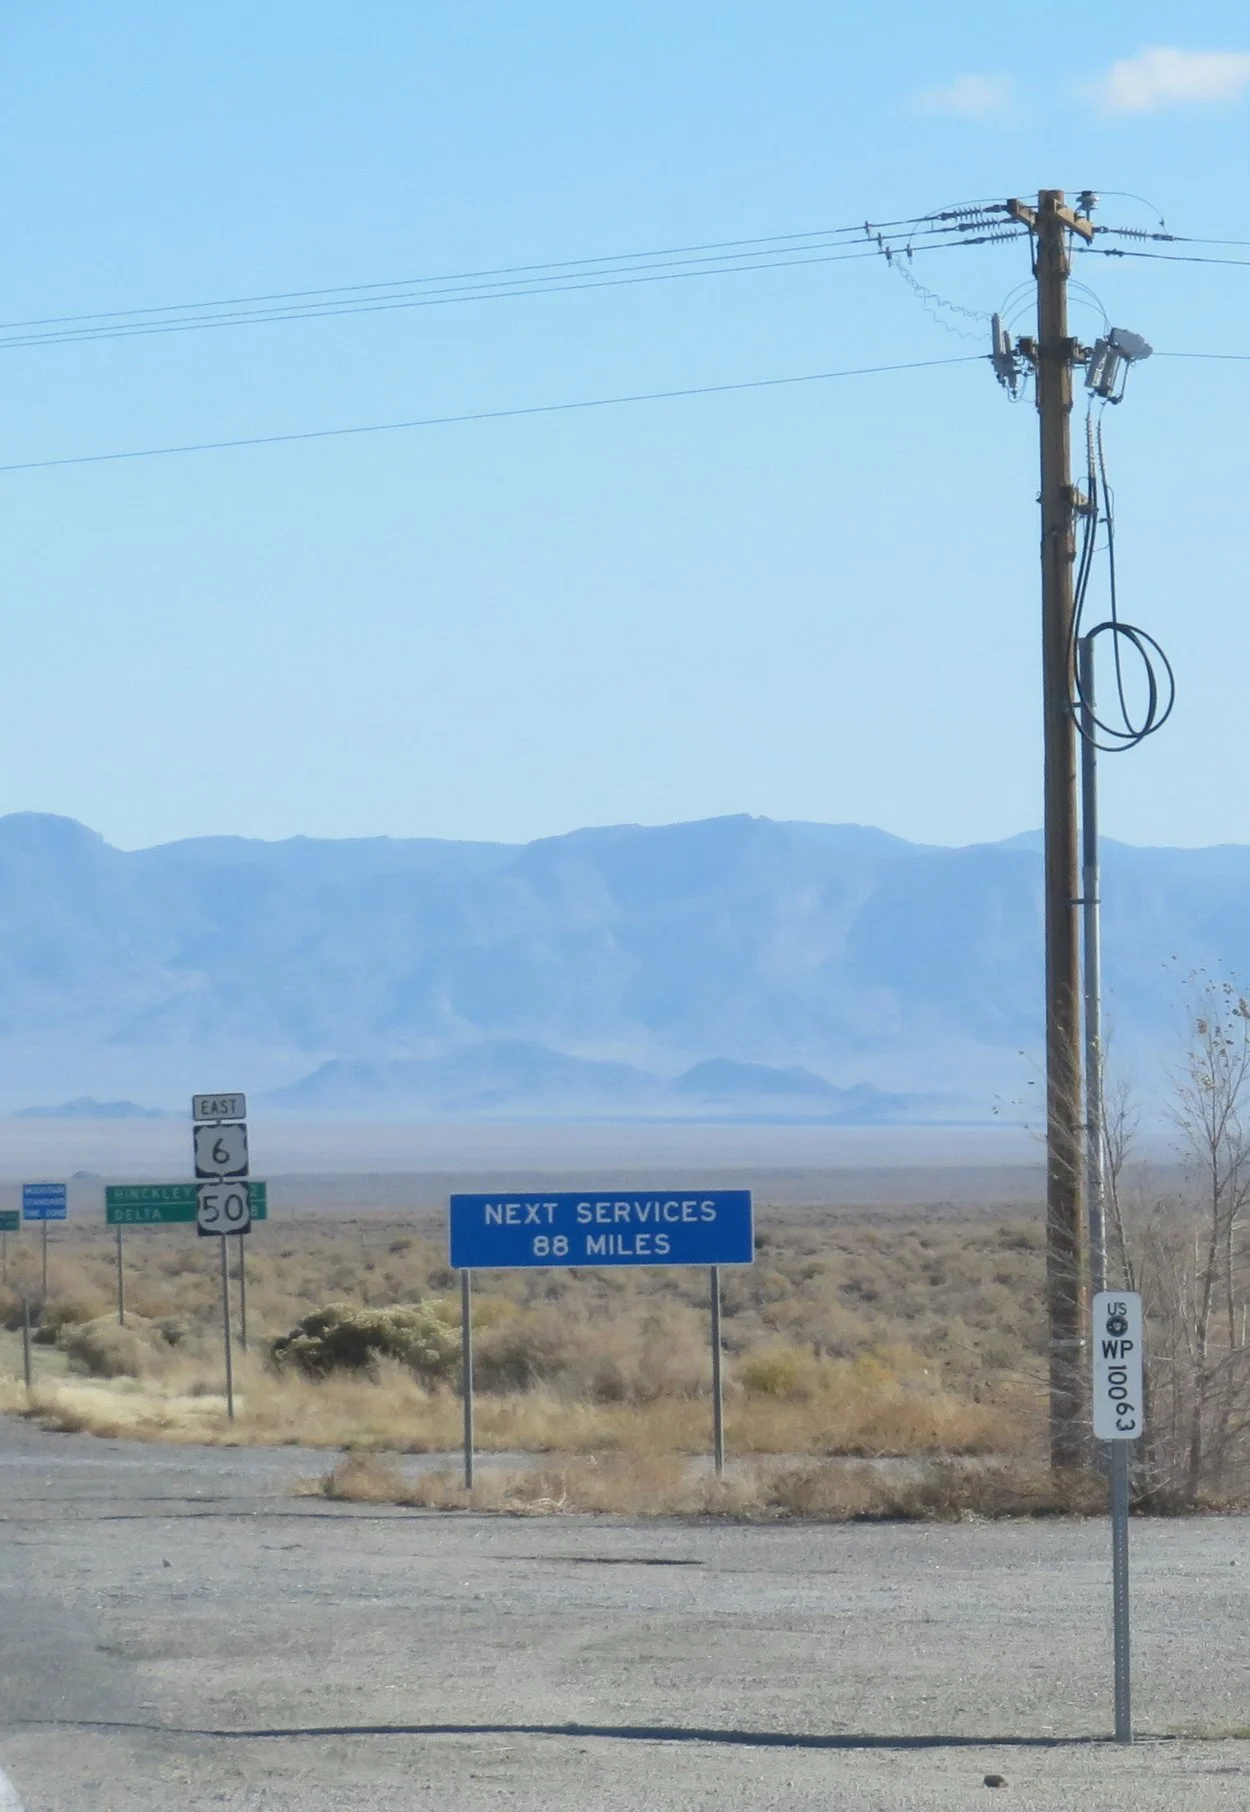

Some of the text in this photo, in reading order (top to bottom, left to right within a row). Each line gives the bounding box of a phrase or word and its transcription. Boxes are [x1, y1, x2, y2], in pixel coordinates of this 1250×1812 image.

[201, 1099, 237, 1116] EAST
[211, 1137, 230, 1164] 6
[114, 1187, 193, 1200] HINCKLEY
[114, 1208, 162, 1221] DELTA
[203, 1194, 243, 1222] 50
[484, 1201, 717, 1225] NEXT SERVICES
[533, 1234, 671, 1256] 88 MILES
[1107, 1302, 1128, 1317] US
[1102, 1340, 1134, 1360] WP
